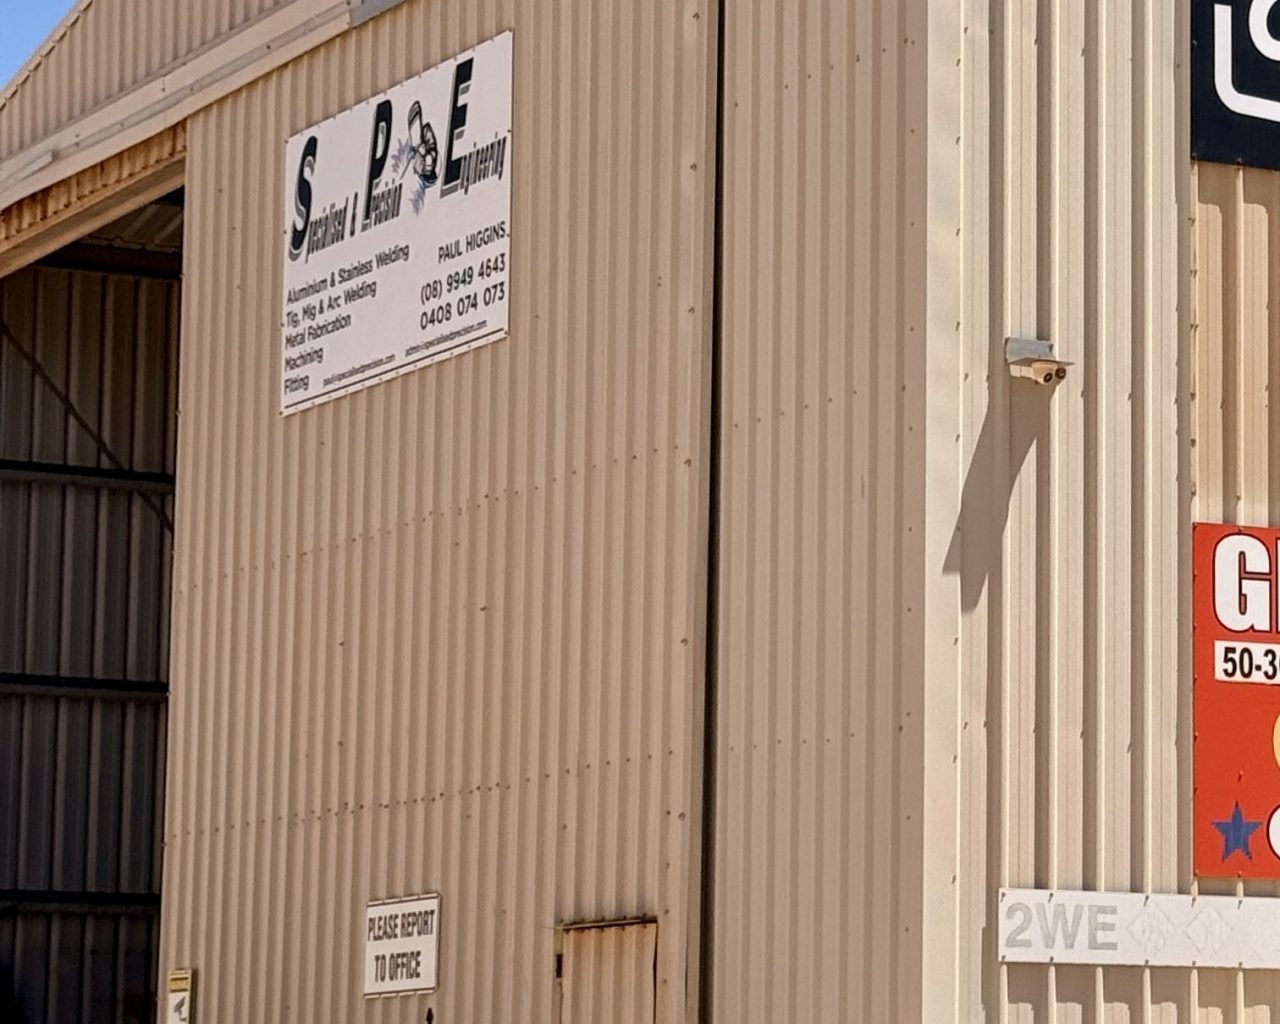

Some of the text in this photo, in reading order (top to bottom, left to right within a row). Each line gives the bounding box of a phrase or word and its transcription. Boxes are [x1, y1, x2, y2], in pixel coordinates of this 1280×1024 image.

[440, 57, 507, 199] Engineering
[438, 221, 506, 263] PAUL HIGGINS
[286, 277, 329, 305] Aluminium
[338, 259, 374, 284] Stainless
[375, 244, 410, 270] Welding
[421, 253, 506, 305] (08) 9949 4643
[327, 294, 341, 311] Arc
[343, 280, 377, 305] Welding
[420, 281, 505, 331] 0408 074 073
[285, 313, 352, 349] Metal Fabrication
[285, 347, 324, 372] Machining
[284, 373, 310, 395] Fitting
[368, 909, 435, 942] PLEASE REPORT
[1005, 902, 1119, 951] 2WE
[374, 950, 422, 983] TO OFFICE
